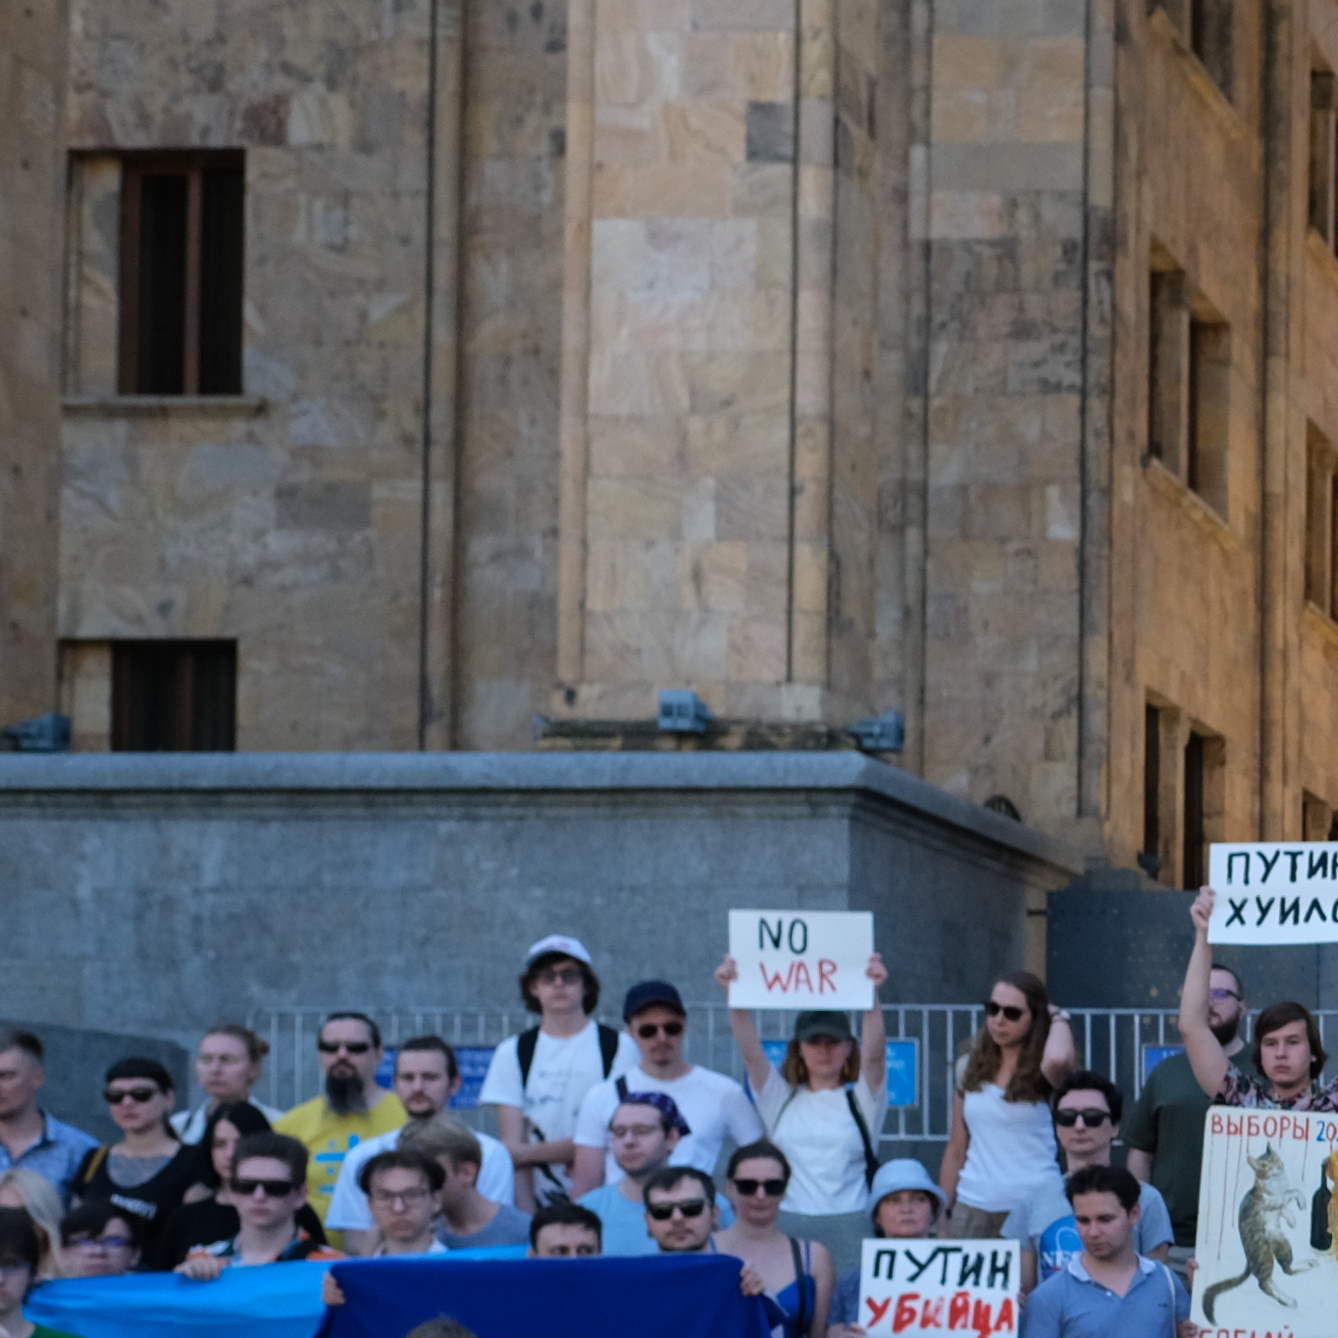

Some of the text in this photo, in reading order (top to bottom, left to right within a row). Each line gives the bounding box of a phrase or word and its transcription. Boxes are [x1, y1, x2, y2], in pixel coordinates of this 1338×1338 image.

[758, 918, 808, 953] NO
[758, 960, 838, 994] WAR
[1211, 1114, 1309, 1143] ВЫБОРЫ
[873, 1247, 1012, 1289] ПУТИН
